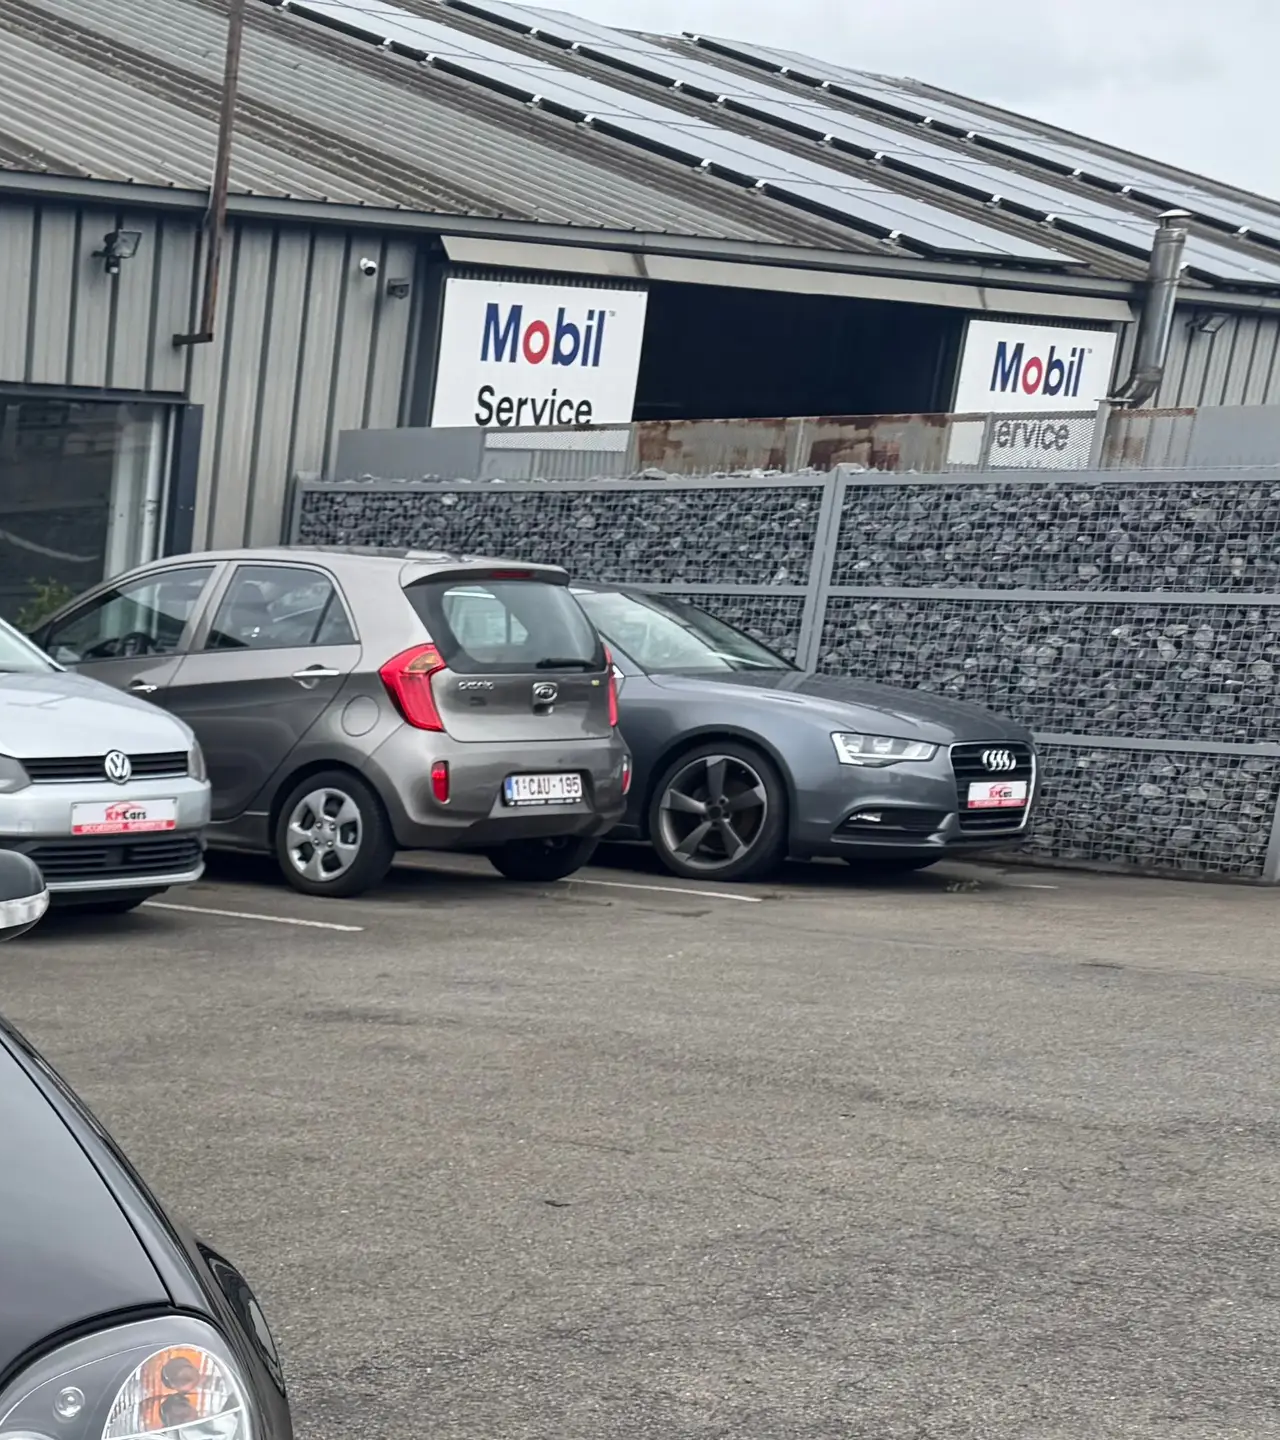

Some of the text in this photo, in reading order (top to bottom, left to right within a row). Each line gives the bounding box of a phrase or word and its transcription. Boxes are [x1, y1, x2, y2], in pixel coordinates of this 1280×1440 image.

[480, 302, 606, 367] Mobil
[990, 341, 1085, 397] Mobil
[475, 385, 592, 426] Service
[996, 421, 1070, 451] ervice
